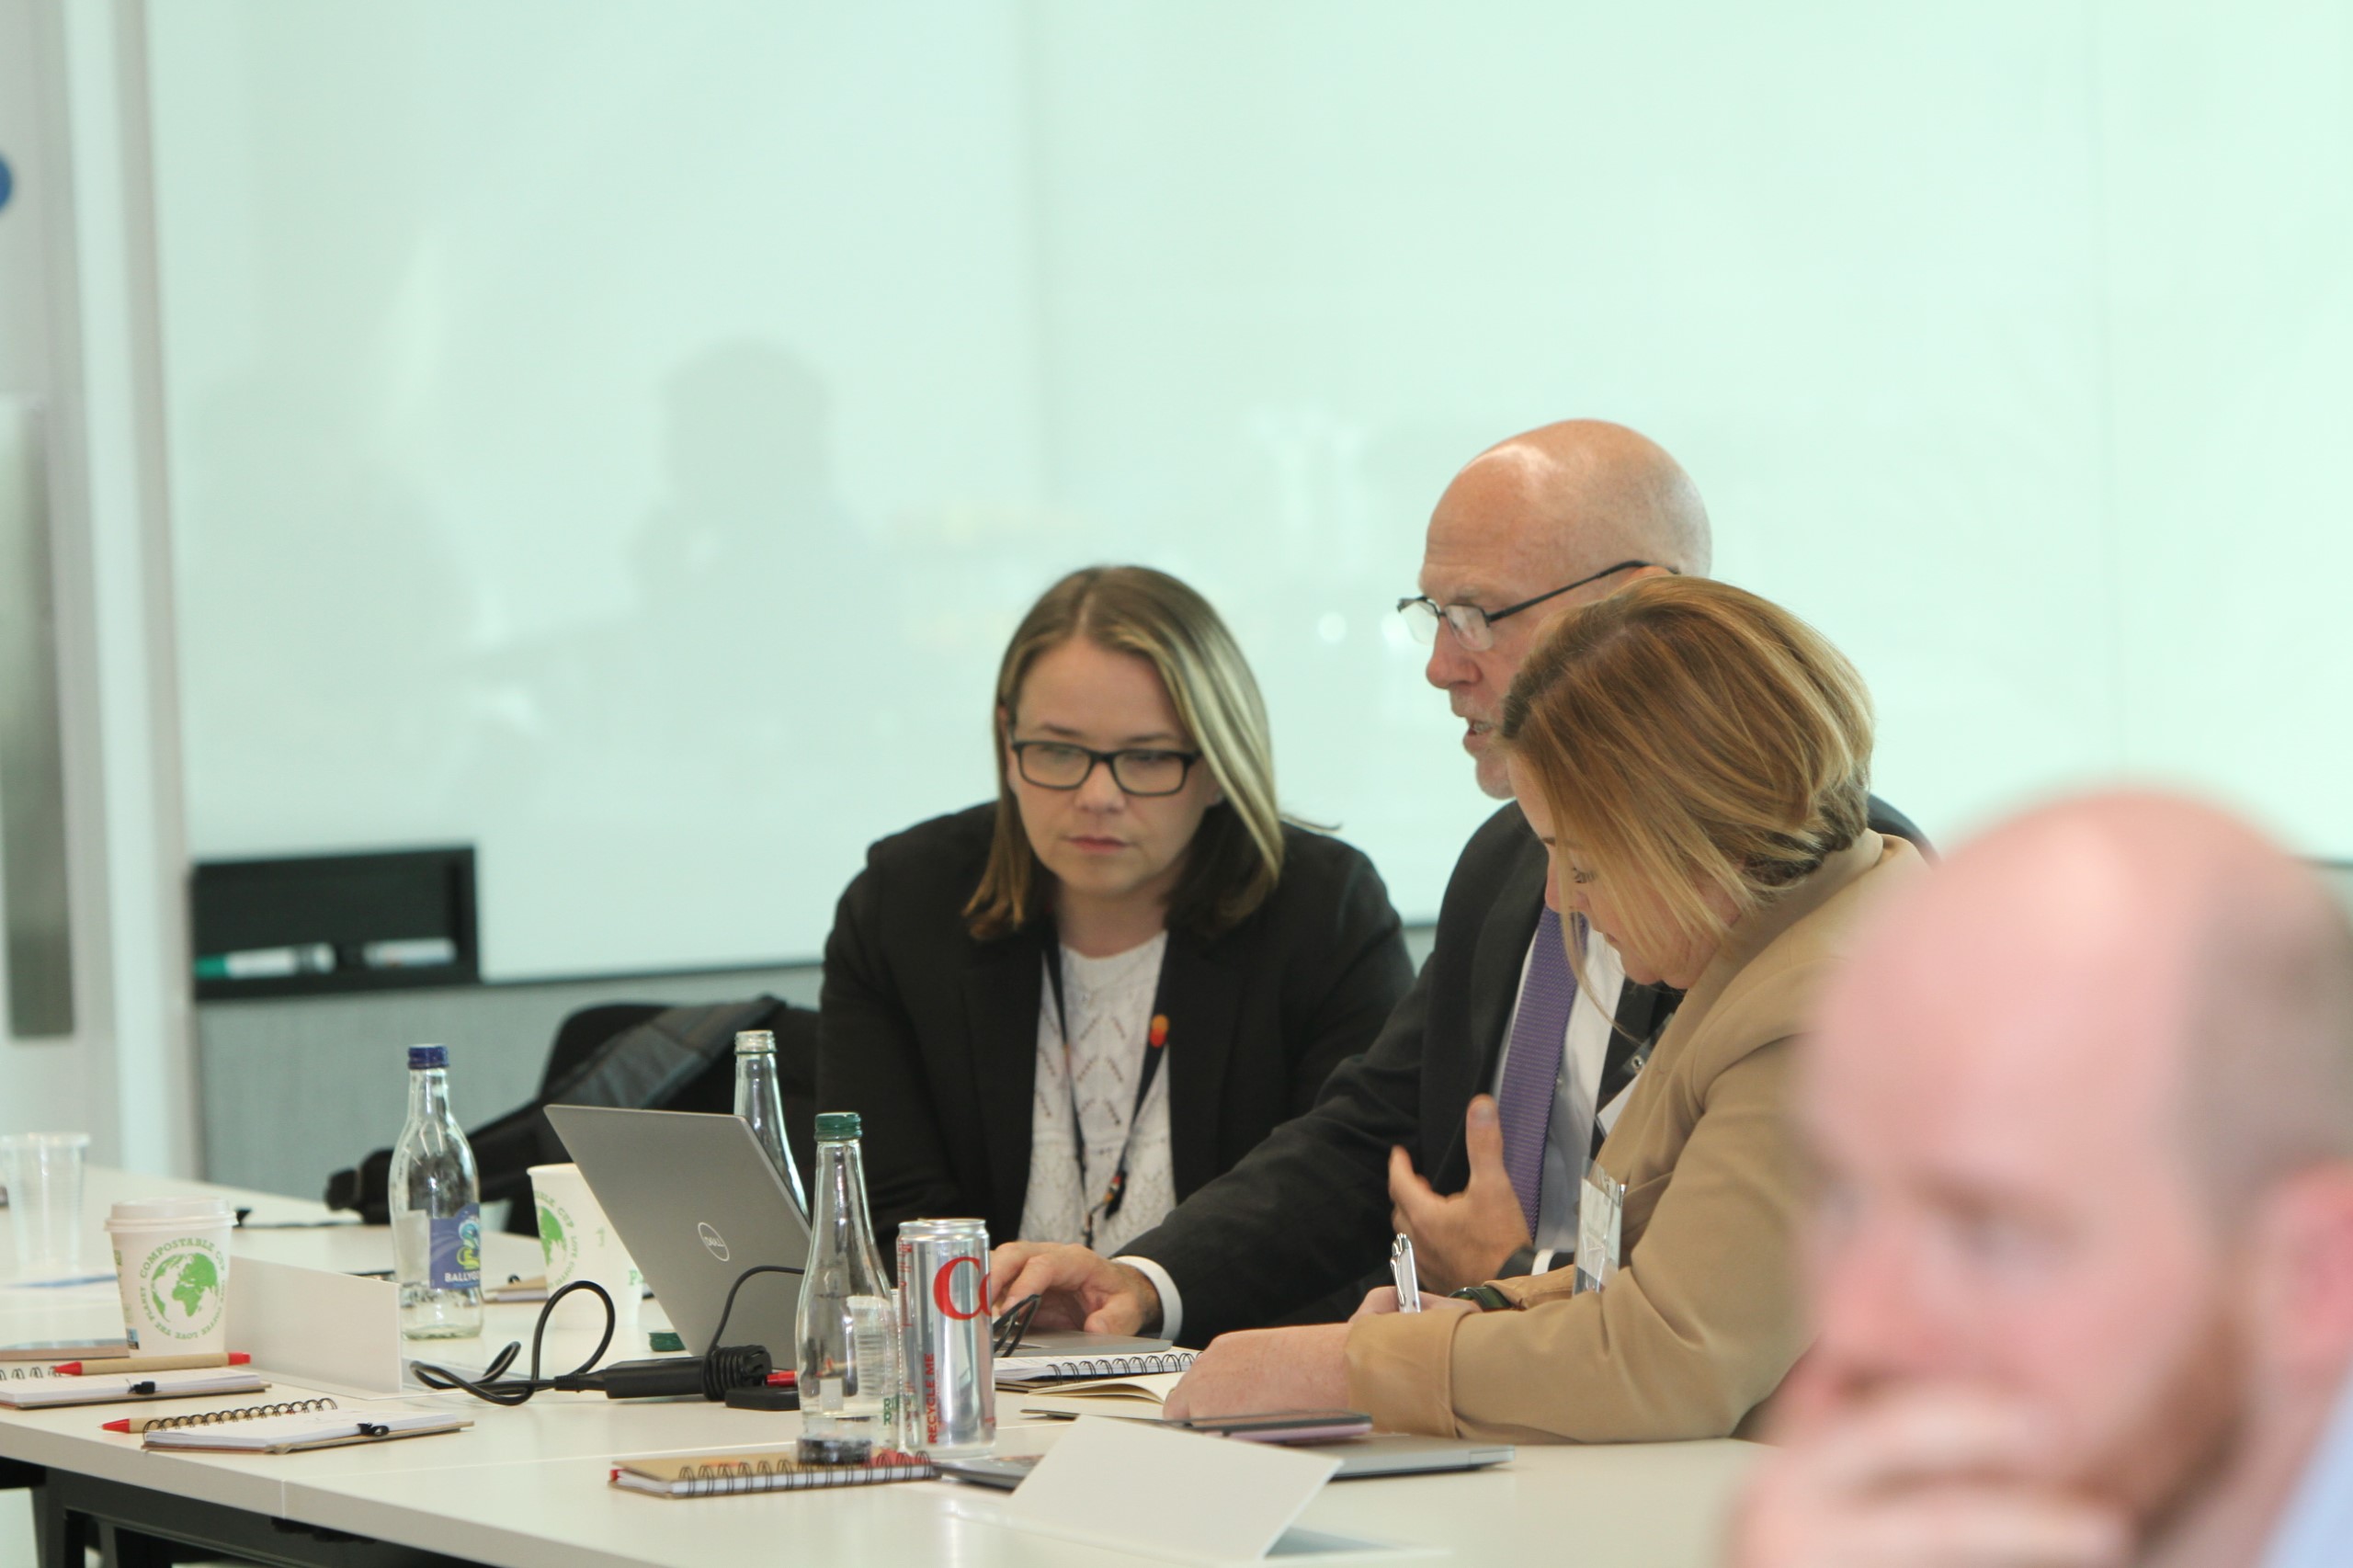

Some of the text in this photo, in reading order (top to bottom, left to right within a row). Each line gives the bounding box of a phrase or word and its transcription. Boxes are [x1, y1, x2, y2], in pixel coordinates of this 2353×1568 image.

[139, 1237, 215, 1278] COMPOSTABLE
[154, 1322, 172, 1336] THE
[175, 1331, 199, 1340] LOVE
[924, 1353, 935, 1375] ME
[925, 1380, 938, 1444] RECYCLE
